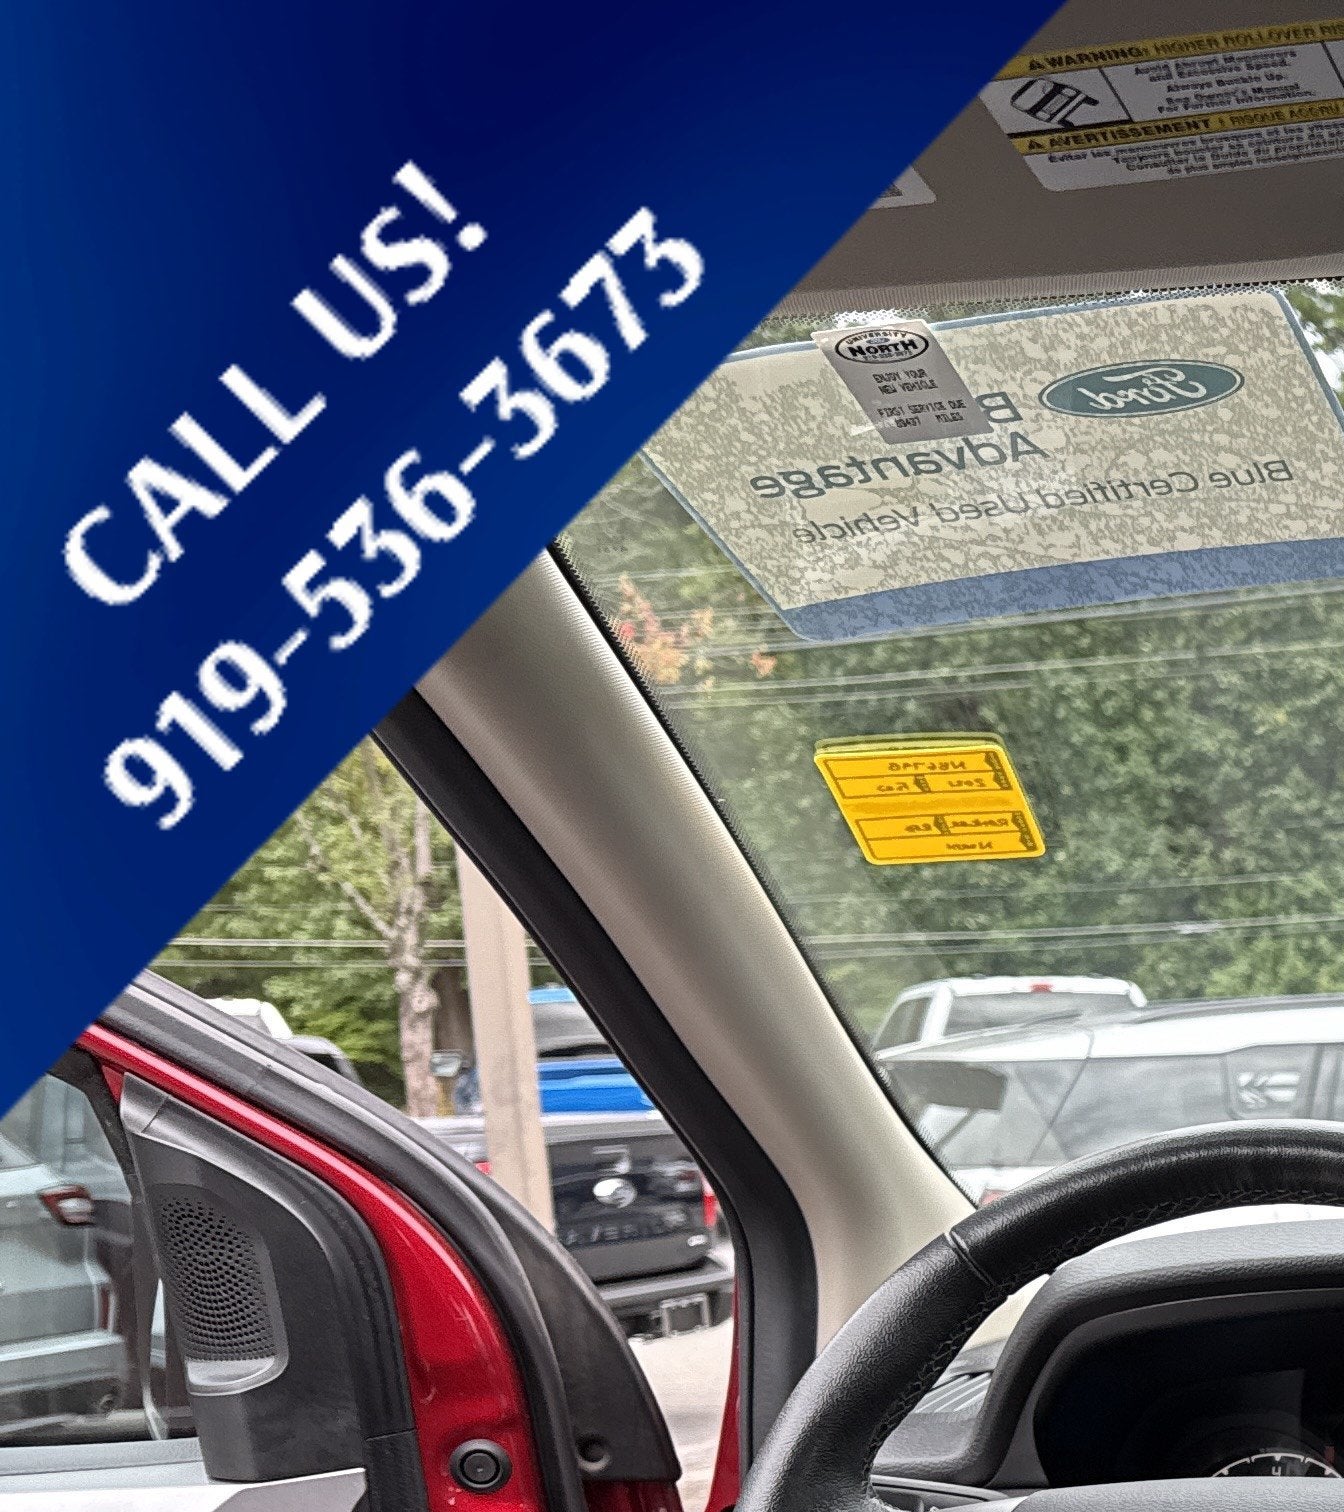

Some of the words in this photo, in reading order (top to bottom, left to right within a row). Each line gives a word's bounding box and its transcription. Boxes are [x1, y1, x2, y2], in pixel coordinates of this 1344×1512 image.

[1046, 46, 1149, 67] WARNING:
[1050, 118, 1210, 149] AVERTISSEMENT
[846, 331, 907, 345] UNIVERSITY
[847, 339, 919, 357] NORTH
[903, 368, 928, 379] YOUR
[878, 384, 898, 395] NEW
[898, 379, 938, 392] VEHICLE
[877, 406, 905, 418] FIRST
[907, 401, 947, 414] SERVICE
[948, 400, 967, 410] DUE
